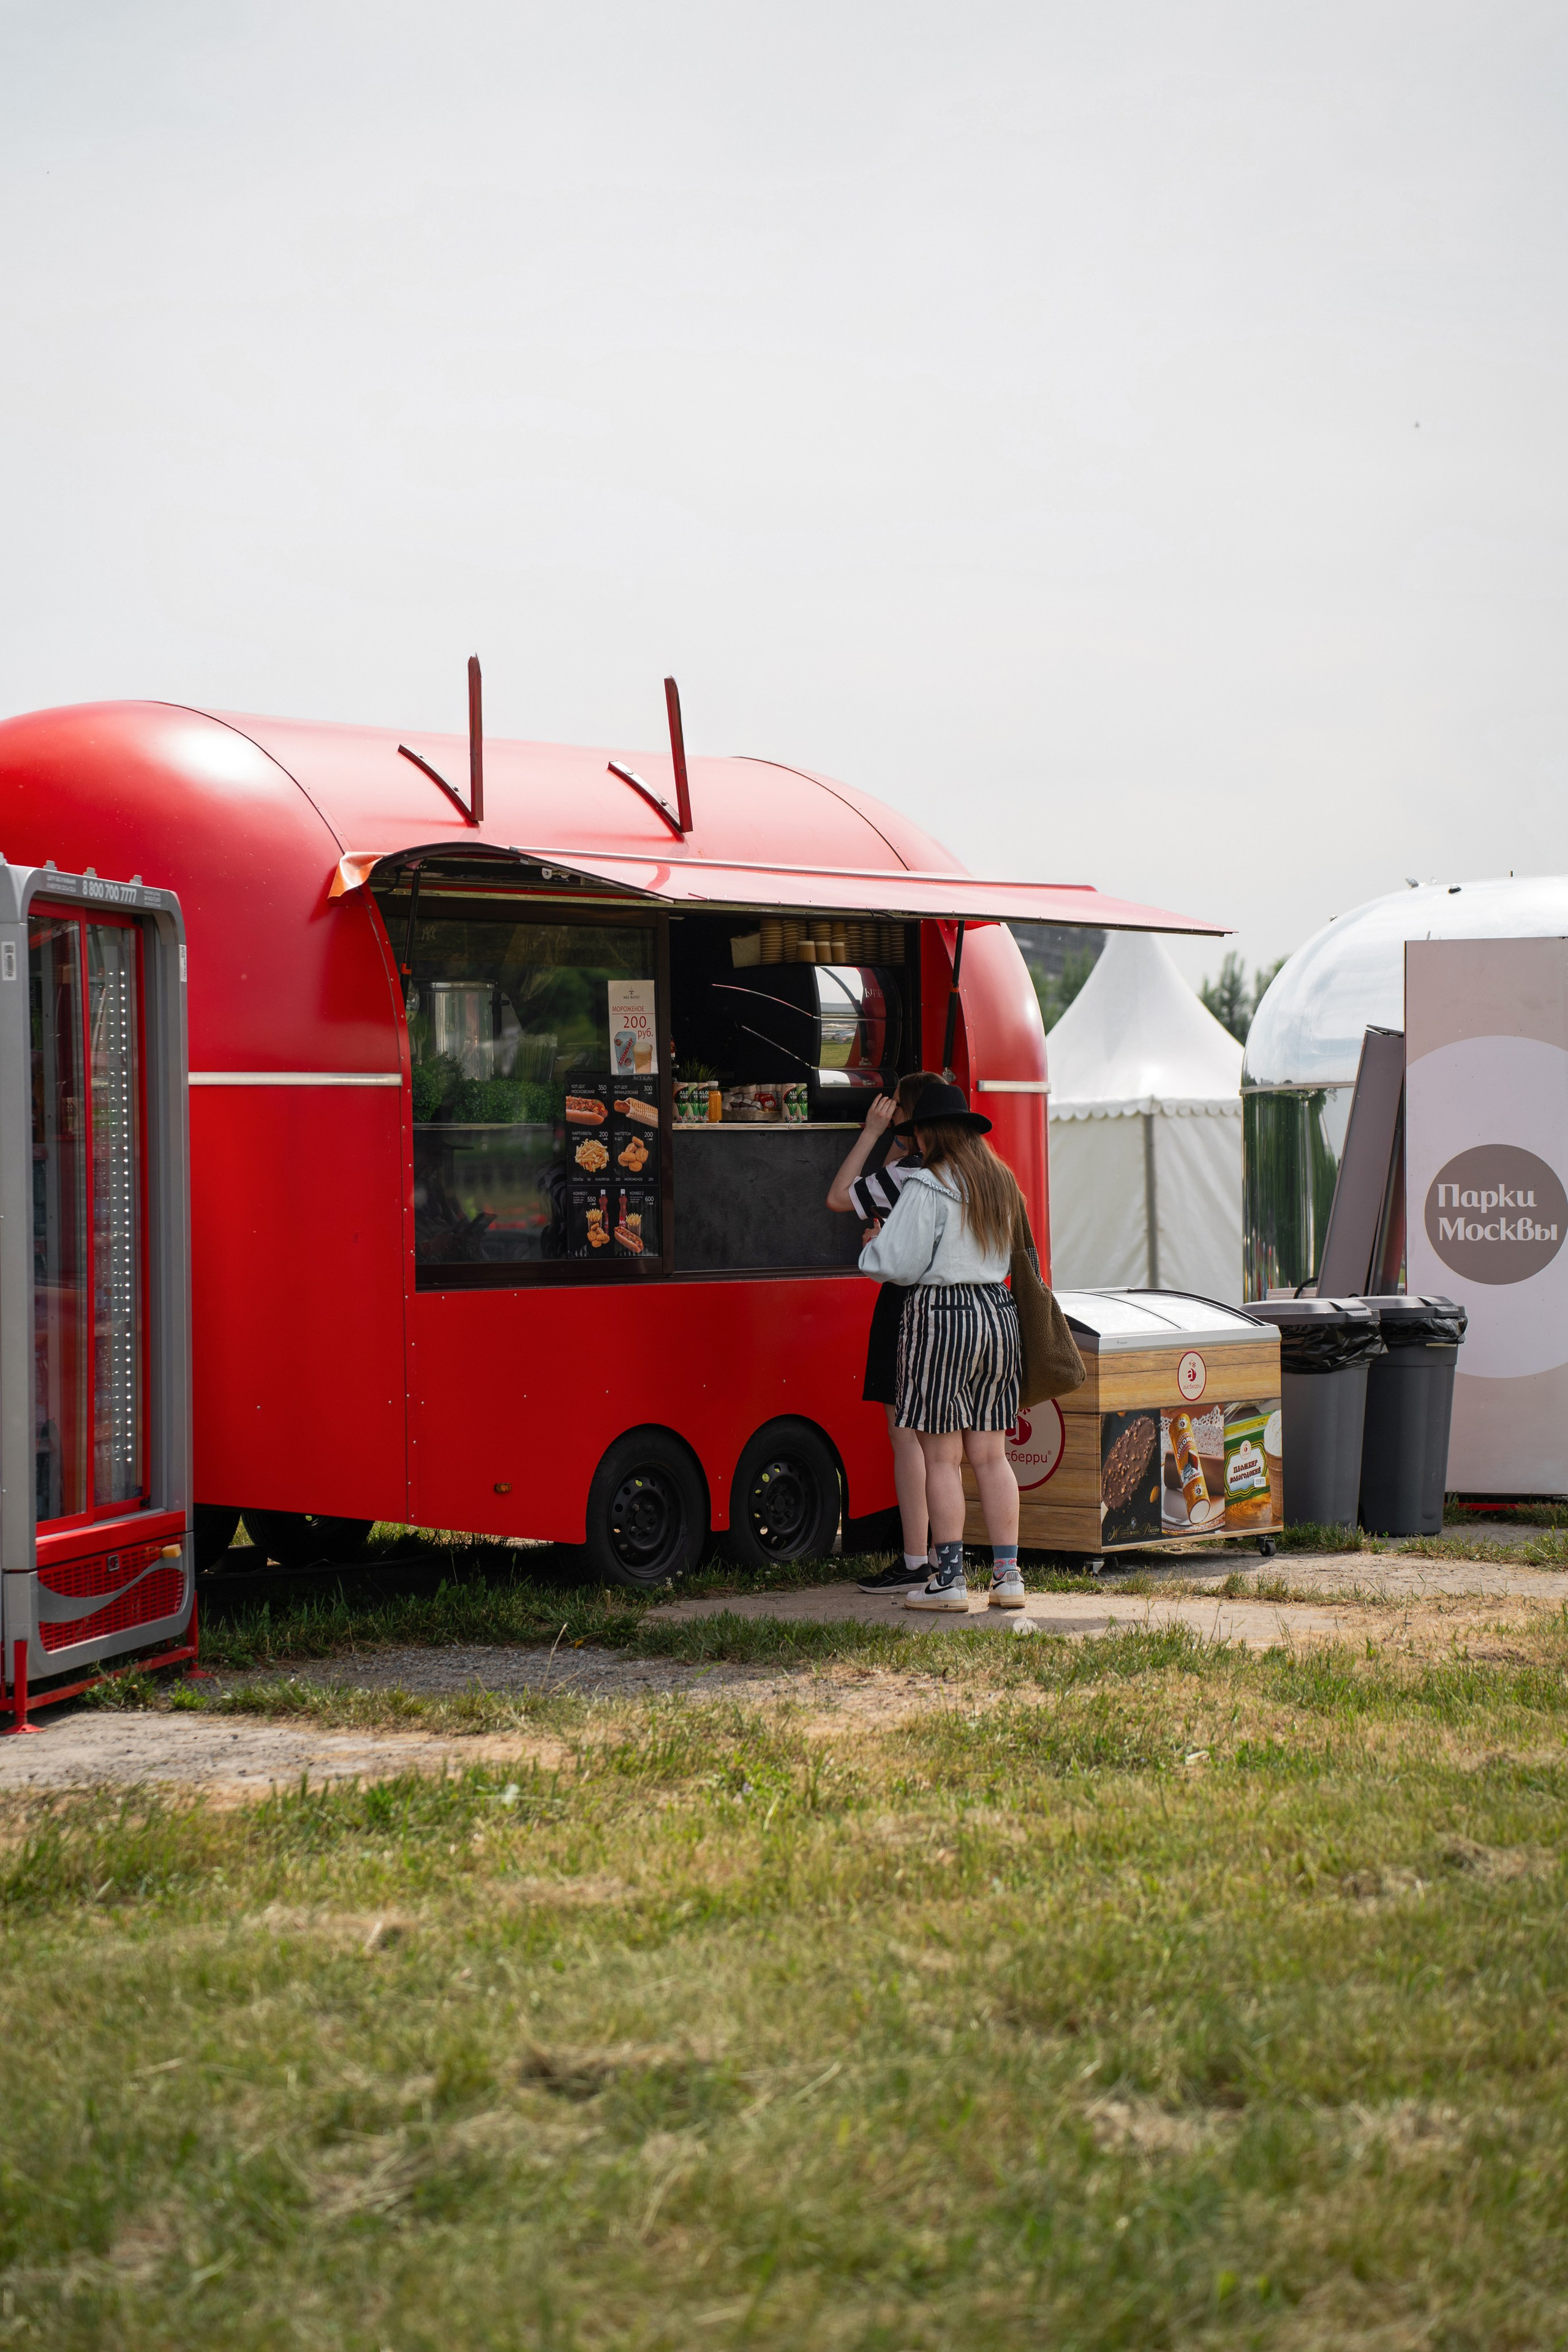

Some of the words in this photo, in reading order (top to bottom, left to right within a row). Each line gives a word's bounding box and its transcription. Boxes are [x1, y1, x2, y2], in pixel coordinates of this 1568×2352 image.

[83, 880, 88, 895] 8
[89, 881, 104, 898] 800
[105, 884, 119, 900] 700
[120, 886, 137, 903] 7777
[624, 1016, 646, 1028] 200
[638, 1028, 654, 1039] руб.
[1437, 1183, 1537, 1213] Парки
[1438, 1217, 1558, 1241] Москвы
[1005, 1450, 1047, 1465] сберри
[1233, 1460, 1258, 1474] ПЛОМБИР
